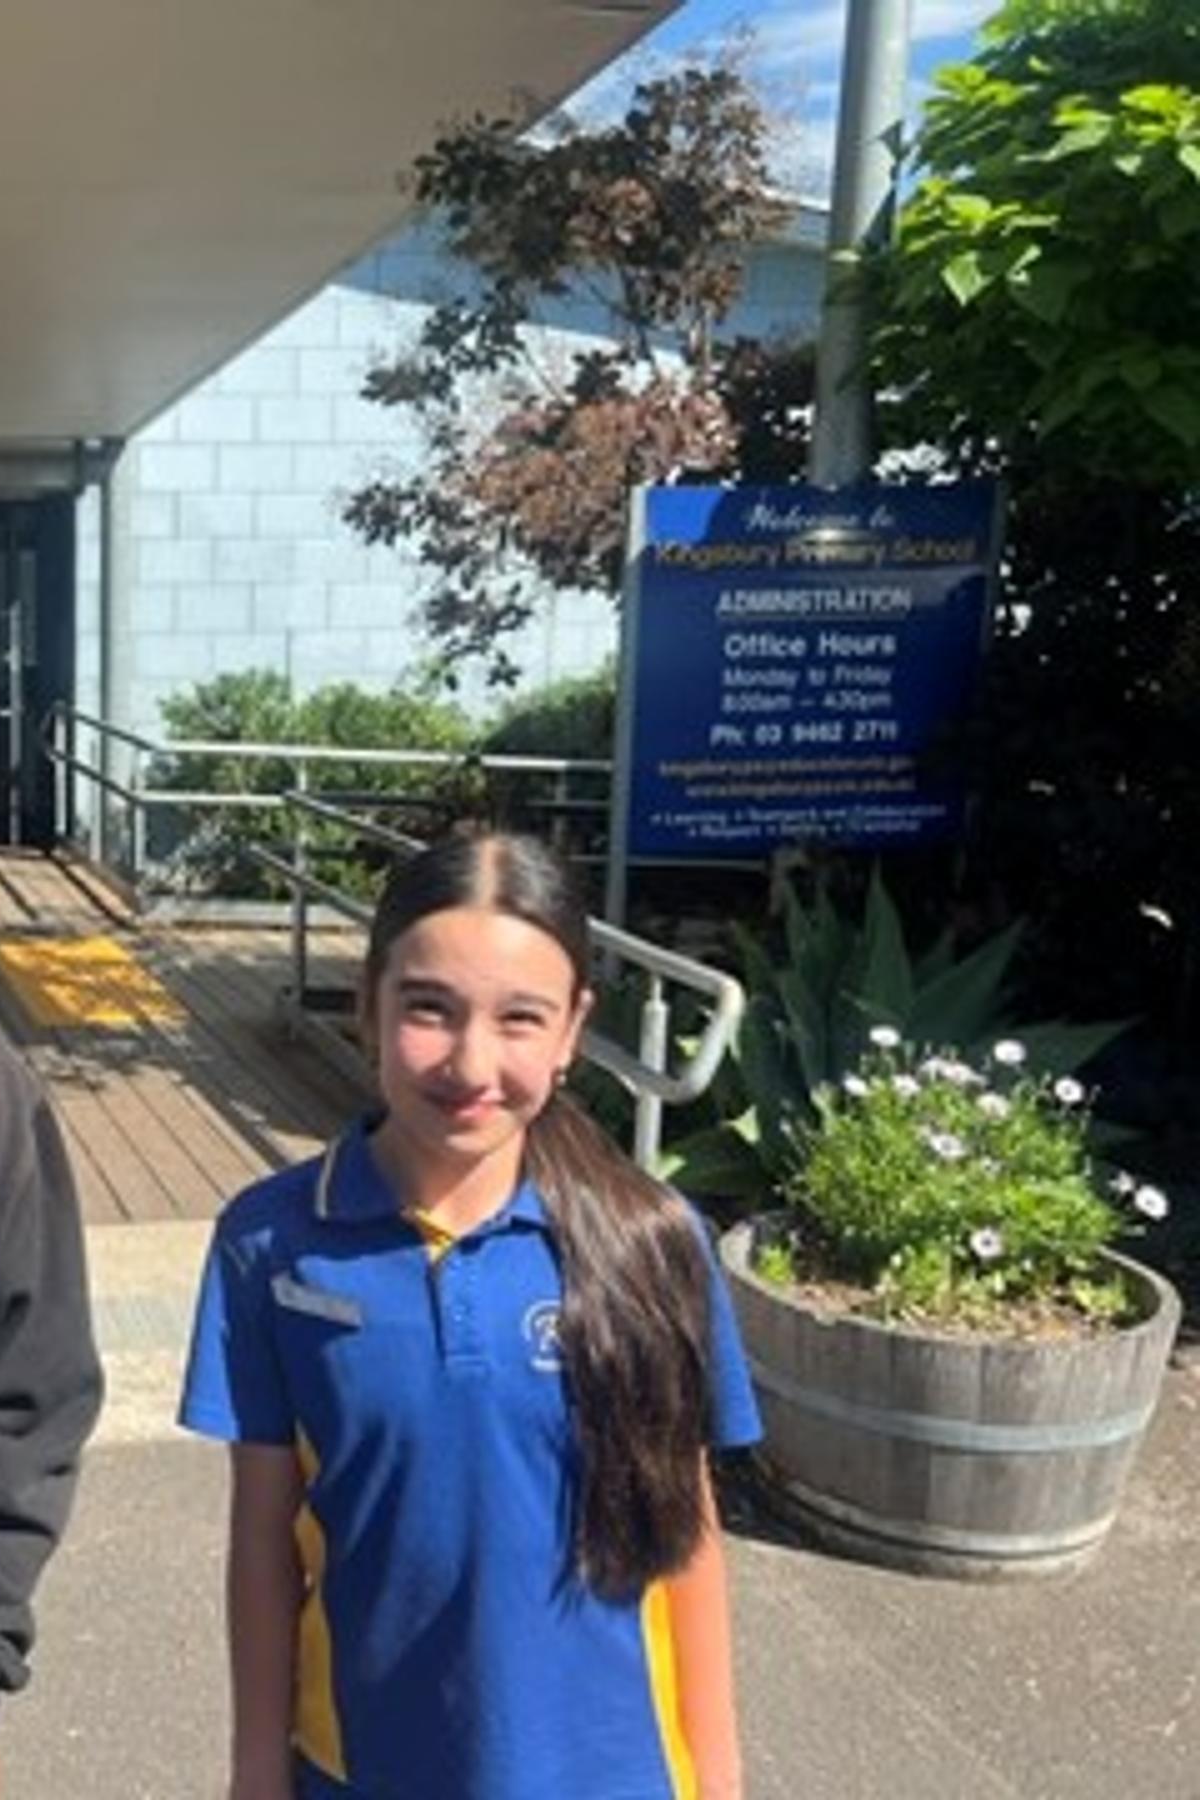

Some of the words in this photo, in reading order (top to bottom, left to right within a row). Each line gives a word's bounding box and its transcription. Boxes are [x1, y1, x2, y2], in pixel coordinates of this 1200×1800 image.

[655, 542, 780, 570] Kingsbury
[894, 537, 976, 562] School
[716, 585, 913, 615] ADMINISTRATION
[724, 632, 807, 659] Office
[818, 630, 897, 657] Hours
[723, 667, 798, 690] Monday
[807, 667, 827, 686] to
[834, 664, 894, 687] Friday
[754, 723, 783, 745] 03
[853, 719, 898, 742] 2711
